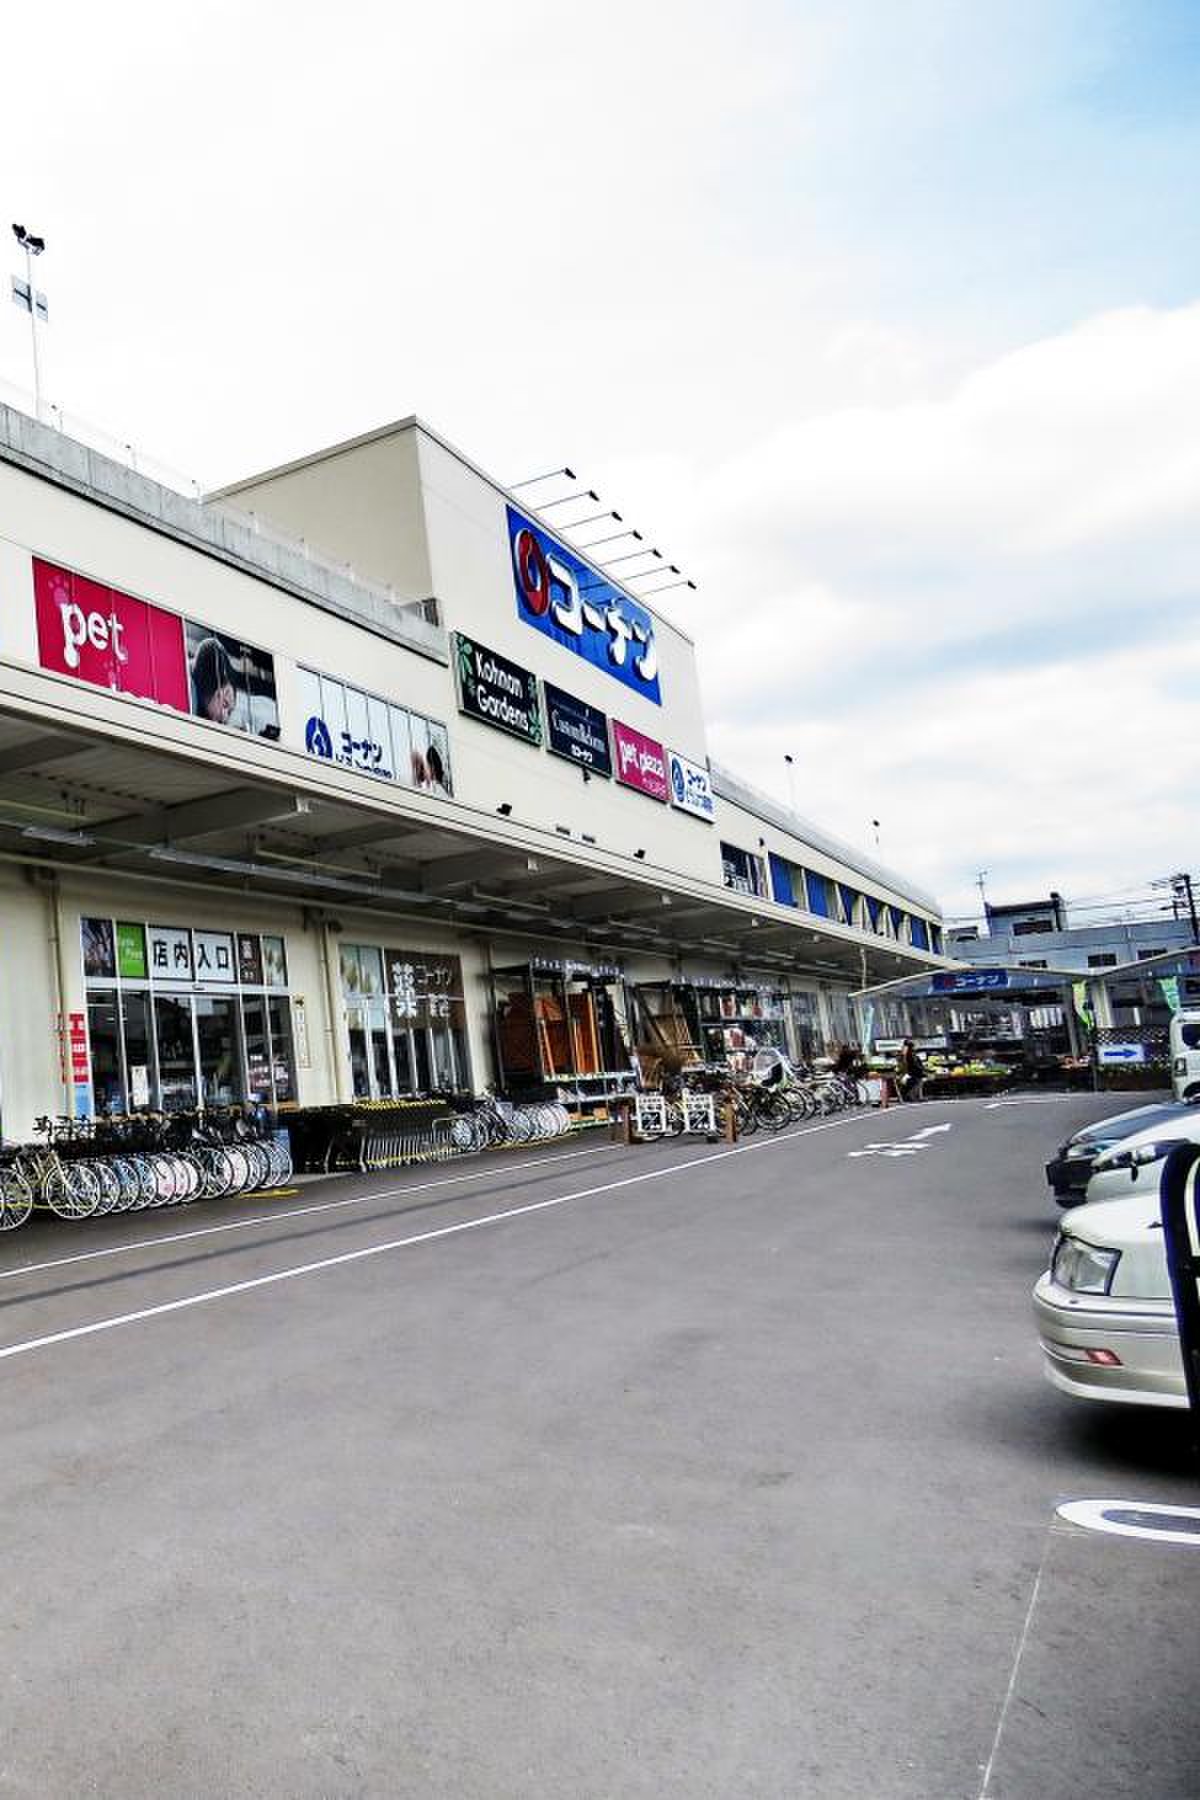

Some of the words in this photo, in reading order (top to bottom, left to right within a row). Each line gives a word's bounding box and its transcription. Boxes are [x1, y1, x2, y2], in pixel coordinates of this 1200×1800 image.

[59, 600, 128, 669] pet
[545, 553, 659, 681] コーナン
[476, 684, 530, 732] Gardens
[341, 732, 383, 763] コーナン
[153, 939, 229, 969] 店内入口
[955, 974, 999, 988] コーナン
